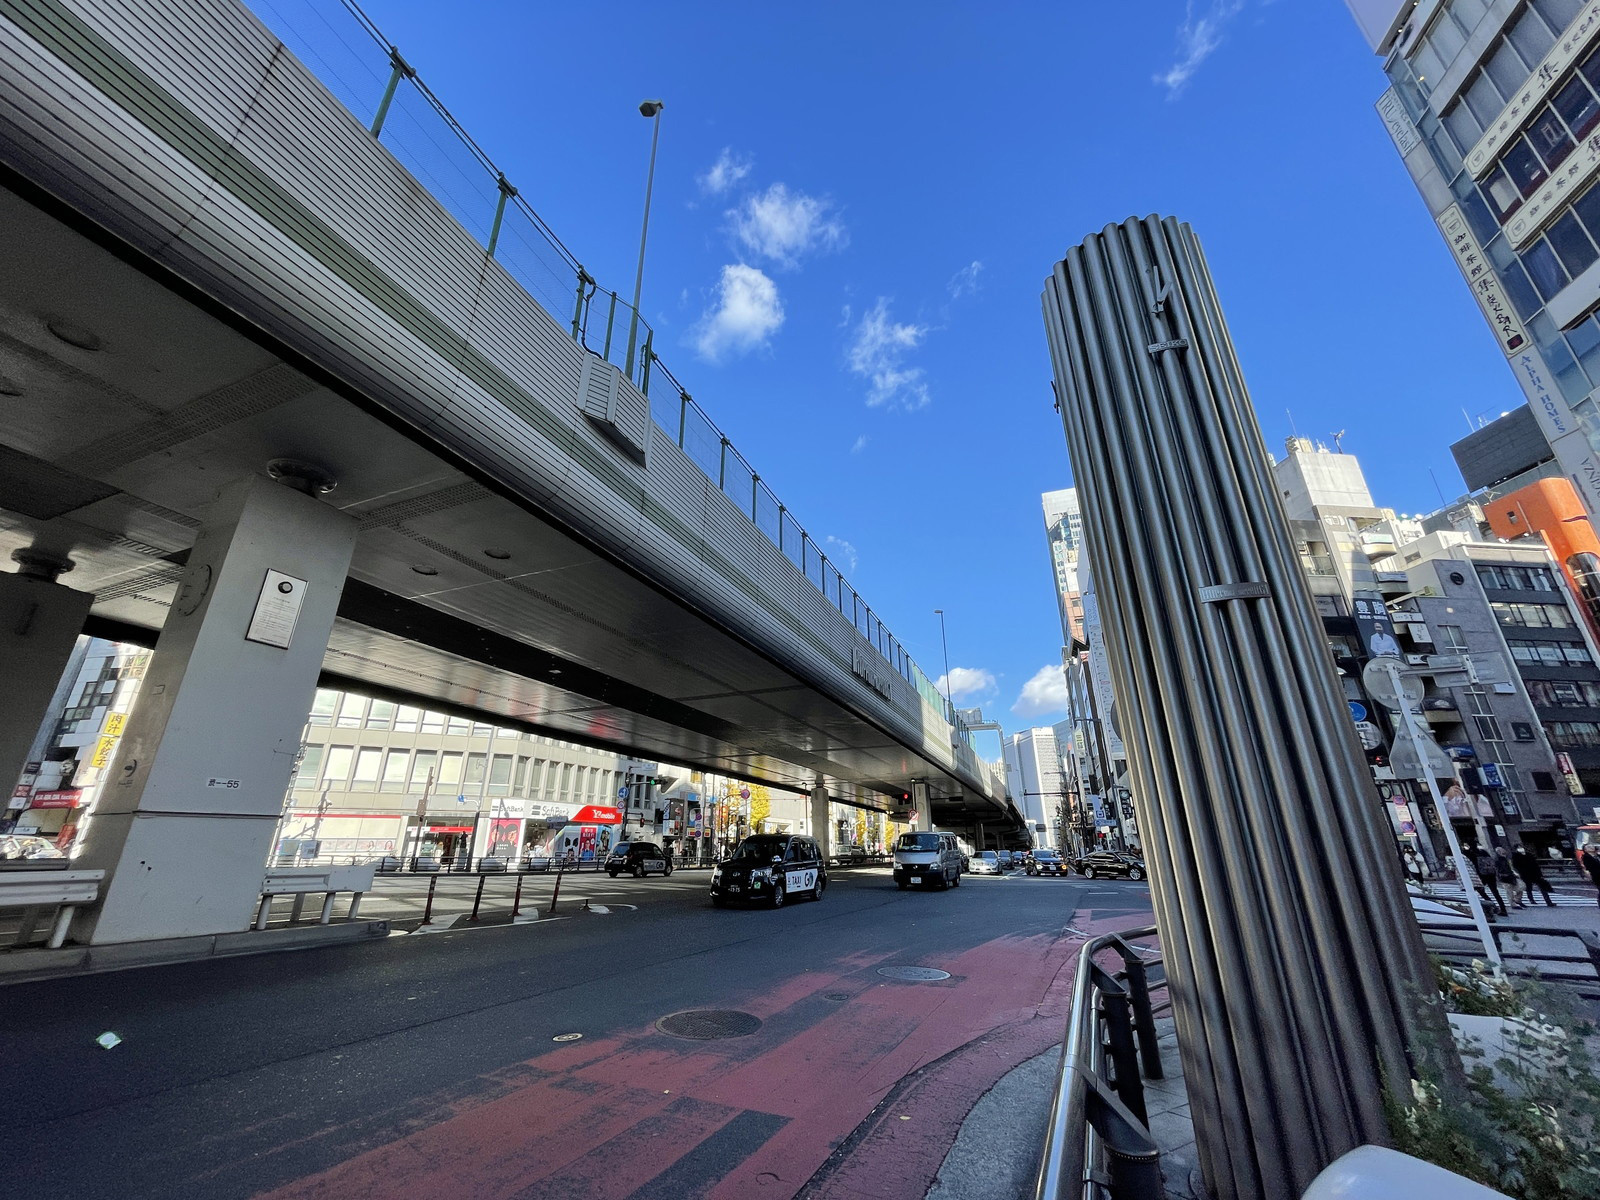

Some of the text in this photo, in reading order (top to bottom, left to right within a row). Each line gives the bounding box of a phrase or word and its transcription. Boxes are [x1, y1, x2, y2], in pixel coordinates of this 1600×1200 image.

[1535, 61, 1559, 90] 集
[1476, 278, 1495, 296] 集
[1520, 355, 1566, 434] ALPHA HOMES
[108, 714, 122, 734] 肉汁
[792, 876, 802, 887] TAXI
